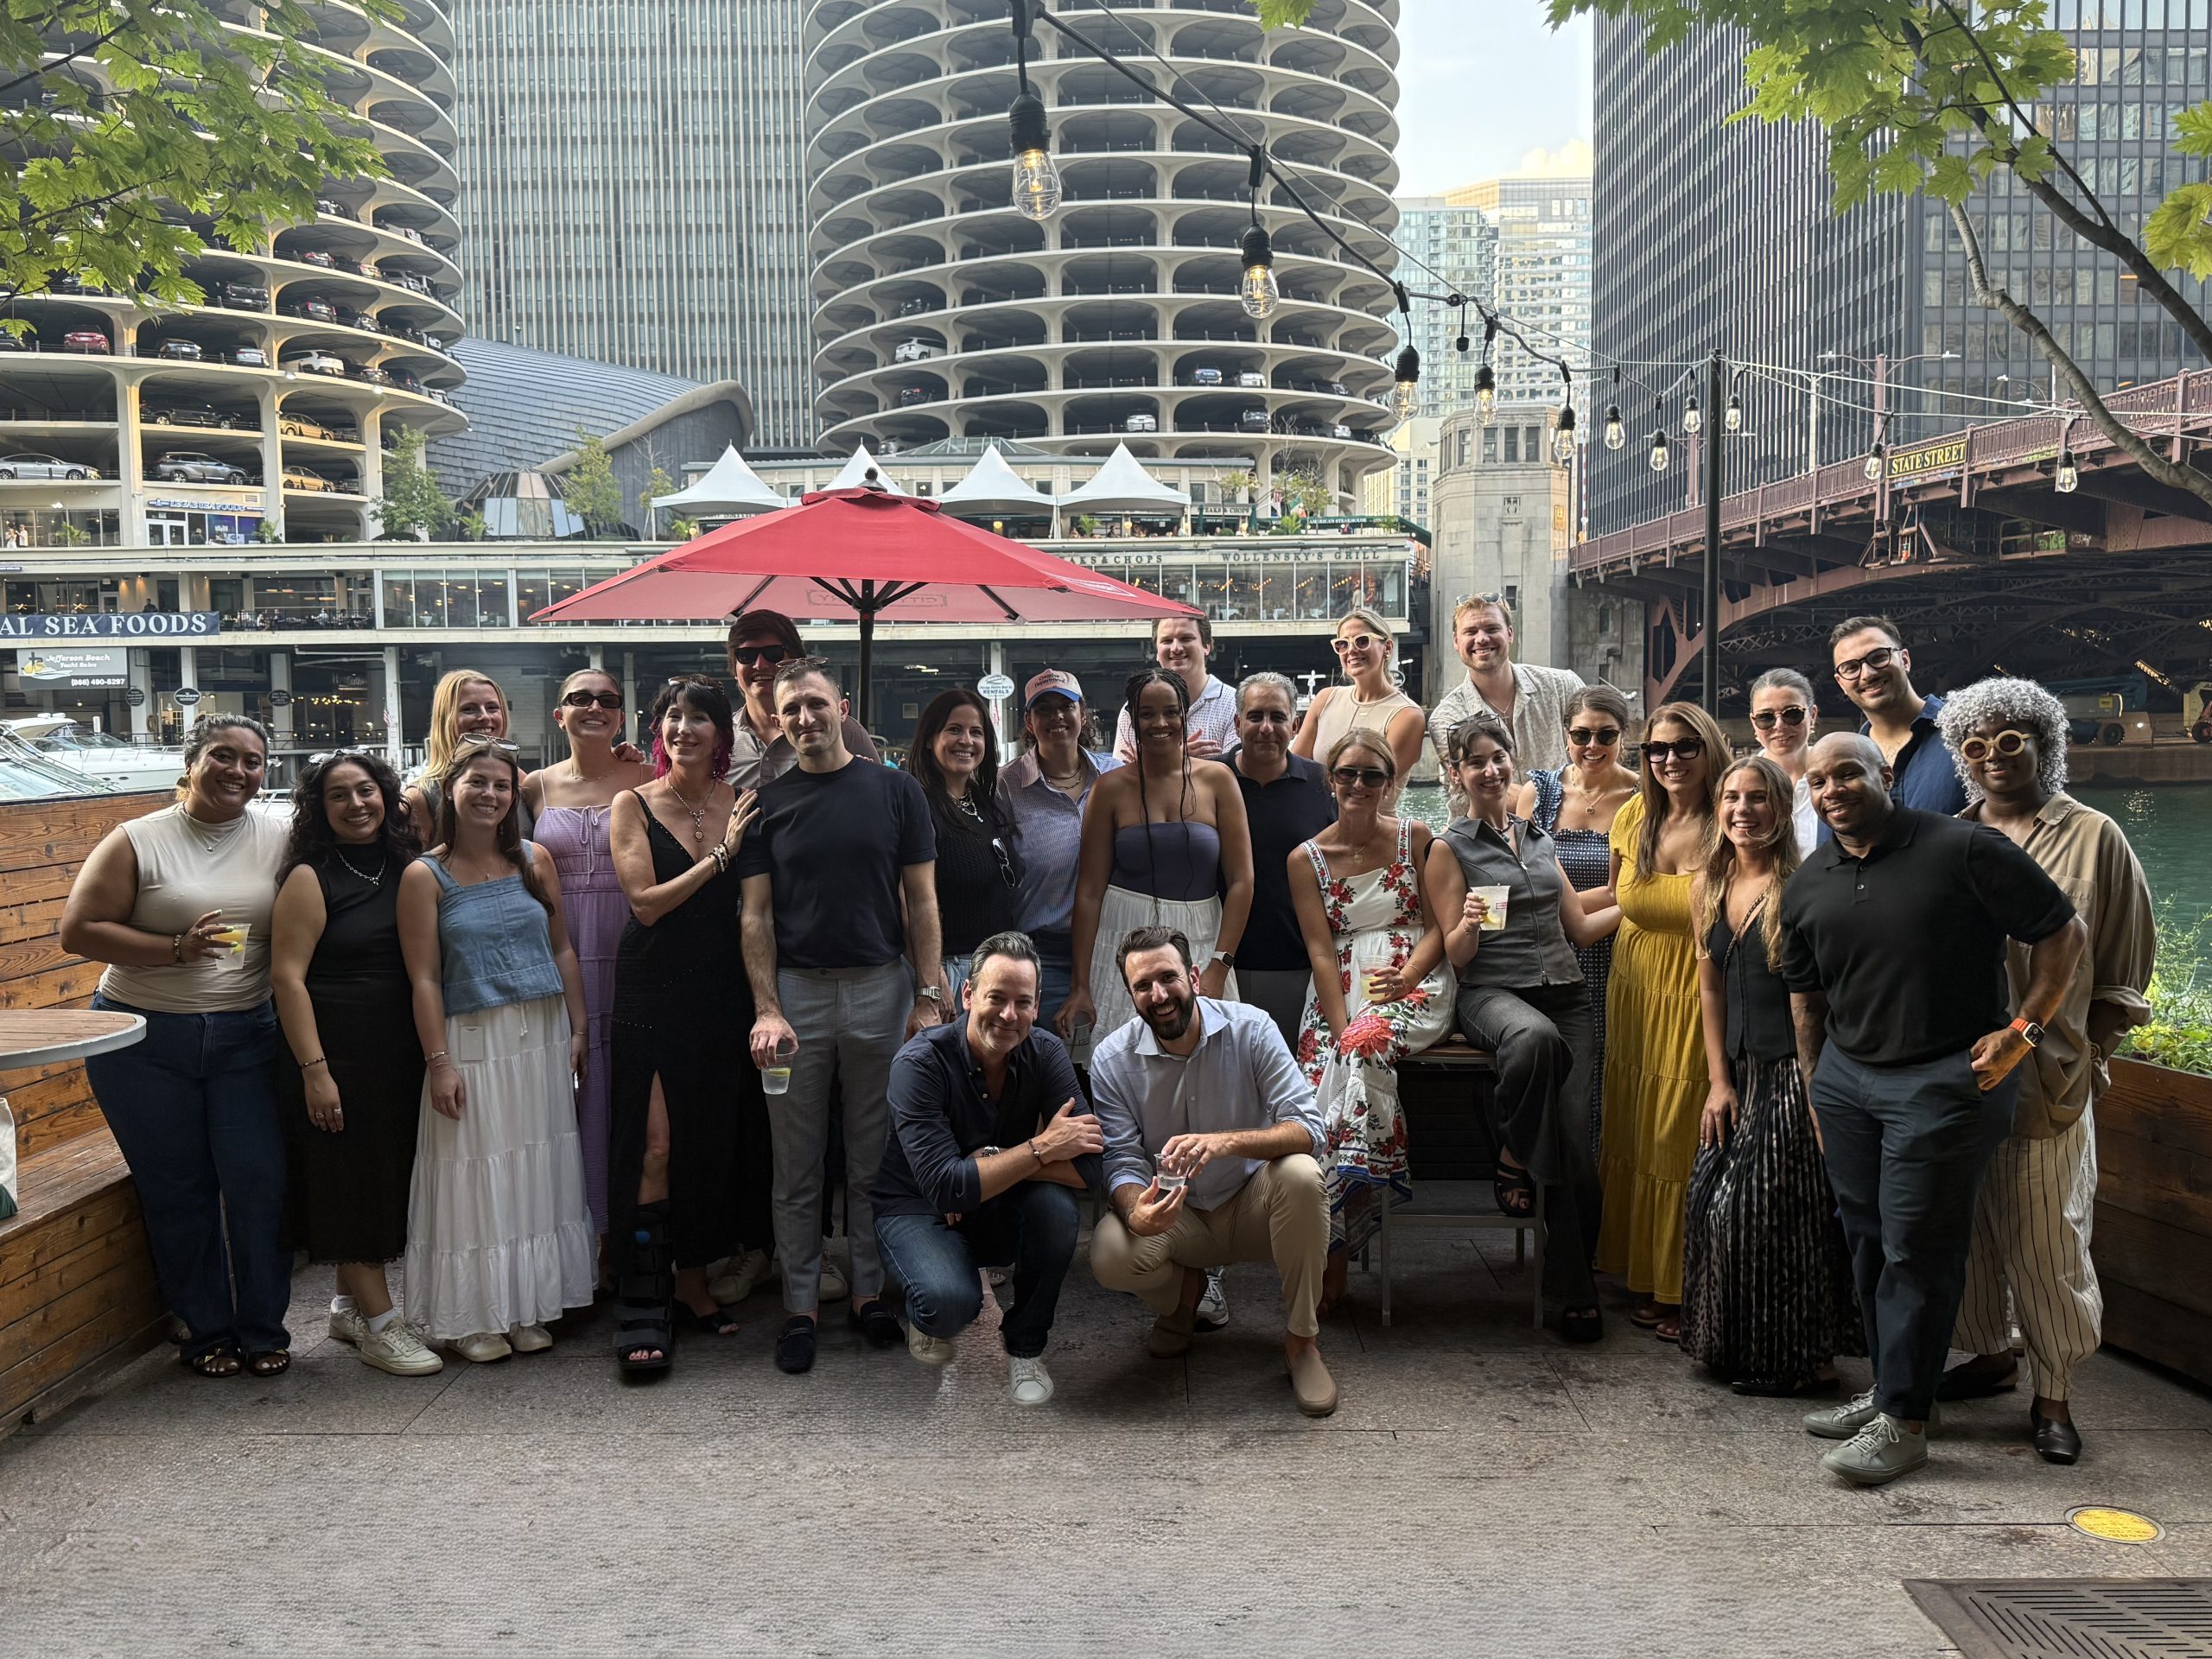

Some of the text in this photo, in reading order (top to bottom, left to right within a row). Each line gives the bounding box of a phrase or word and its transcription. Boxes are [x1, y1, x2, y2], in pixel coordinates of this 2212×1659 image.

[1891, 443, 1966, 474] STATE STREET
[1114, 555, 1162, 564] CHOPS
[1222, 551, 1323, 563] WOLLENSKY'S
[1335, 550, 1380, 560] GRILL
[44, 615, 99, 635] SEA
[110, 613, 207, 634] FOODS
